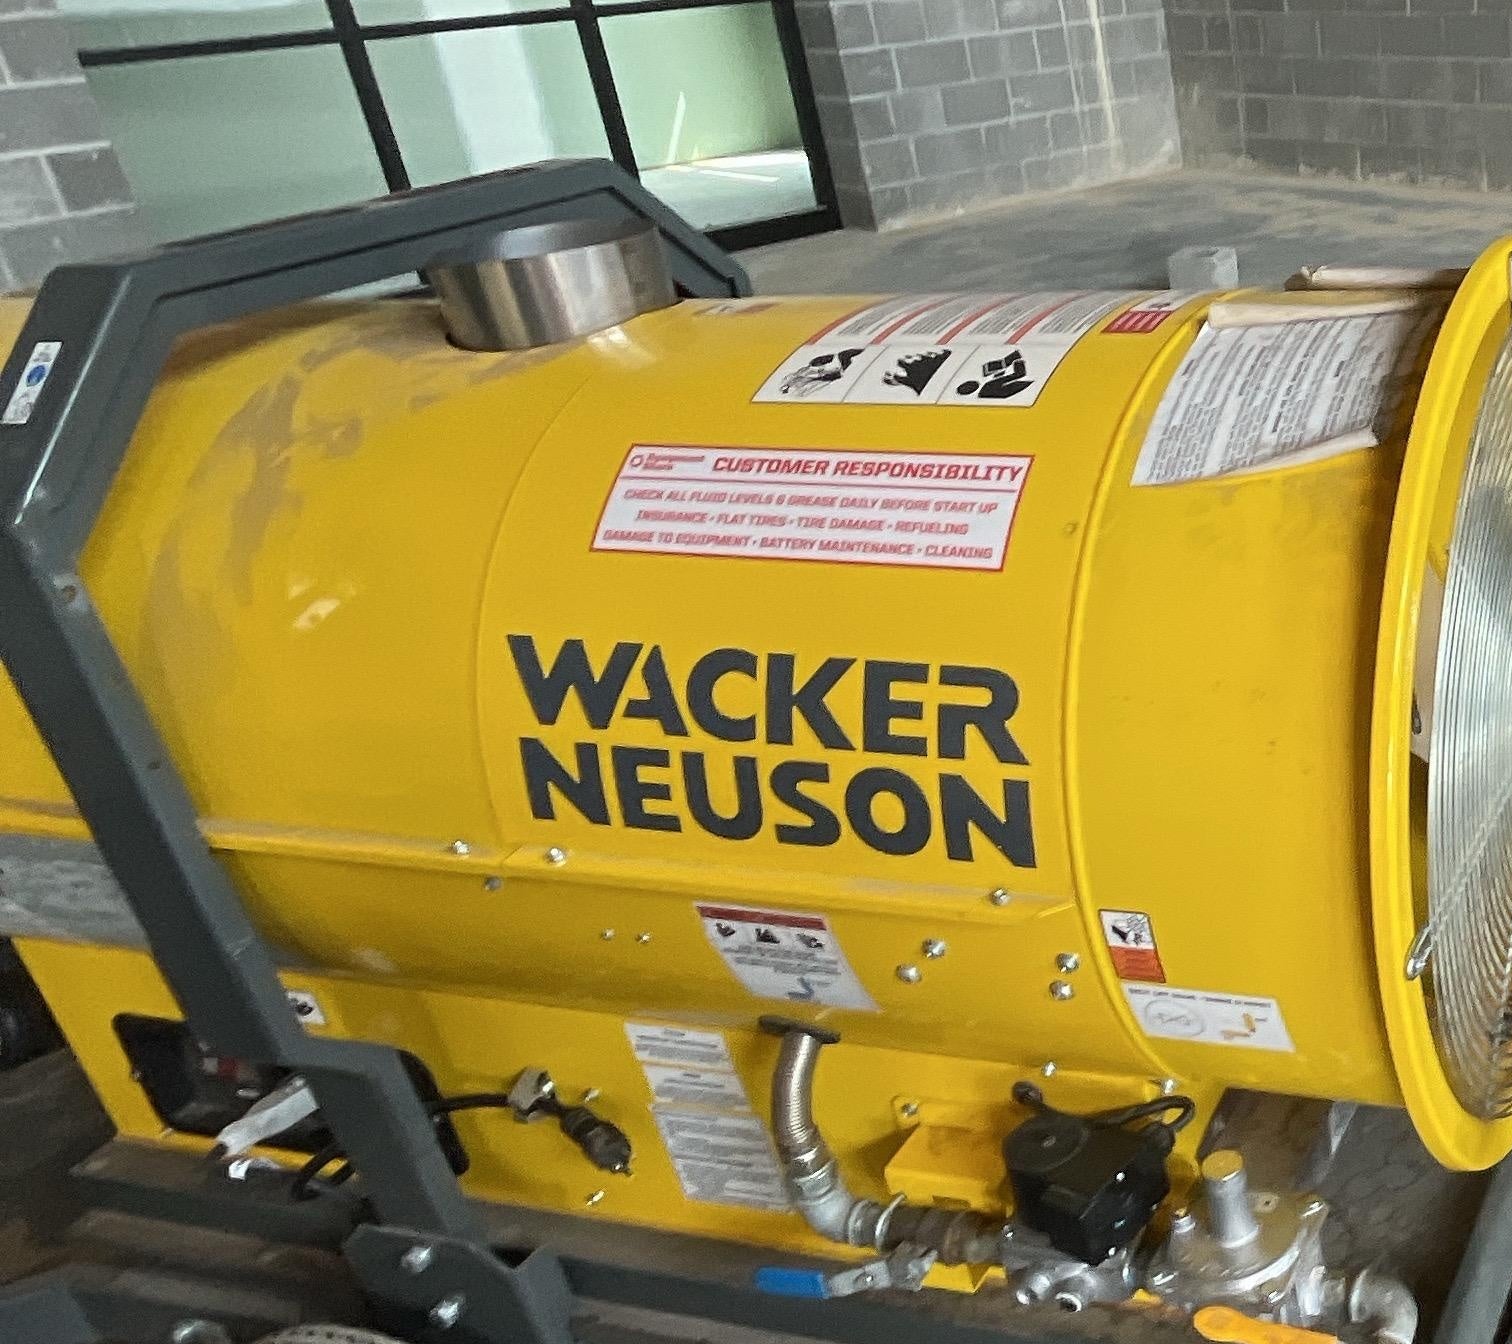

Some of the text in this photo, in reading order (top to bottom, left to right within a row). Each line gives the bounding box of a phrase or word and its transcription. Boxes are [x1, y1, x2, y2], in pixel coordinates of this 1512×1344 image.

[712, 456, 830, 476] CUSTOMER
[833, 460, 1024, 482] RESPONSIBILITY
[623, 488, 663, 501] CHECK
[666, 490, 688, 502] ALL
[689, 491, 727, 504] FLUID
[728, 492, 774, 505] LEVELS
[787, 494, 836, 508] GREASE
[839, 497, 878, 509] DAILY
[880, 498, 930, 511] BEFORE
[934, 500, 974, 513] START
[977, 502, 998, 514] UP
[636, 509, 969, 535] INSURANCE FLAT TIRES TIRE DAMAGE REFUELING
[603, 529, 993, 559] DAMAGE TO EQUIPMENT BATTERY MAINTENANCE CLEANING
[507, 633, 1030, 765] WACKER
[519, 736, 1037, 868] NEUSON
